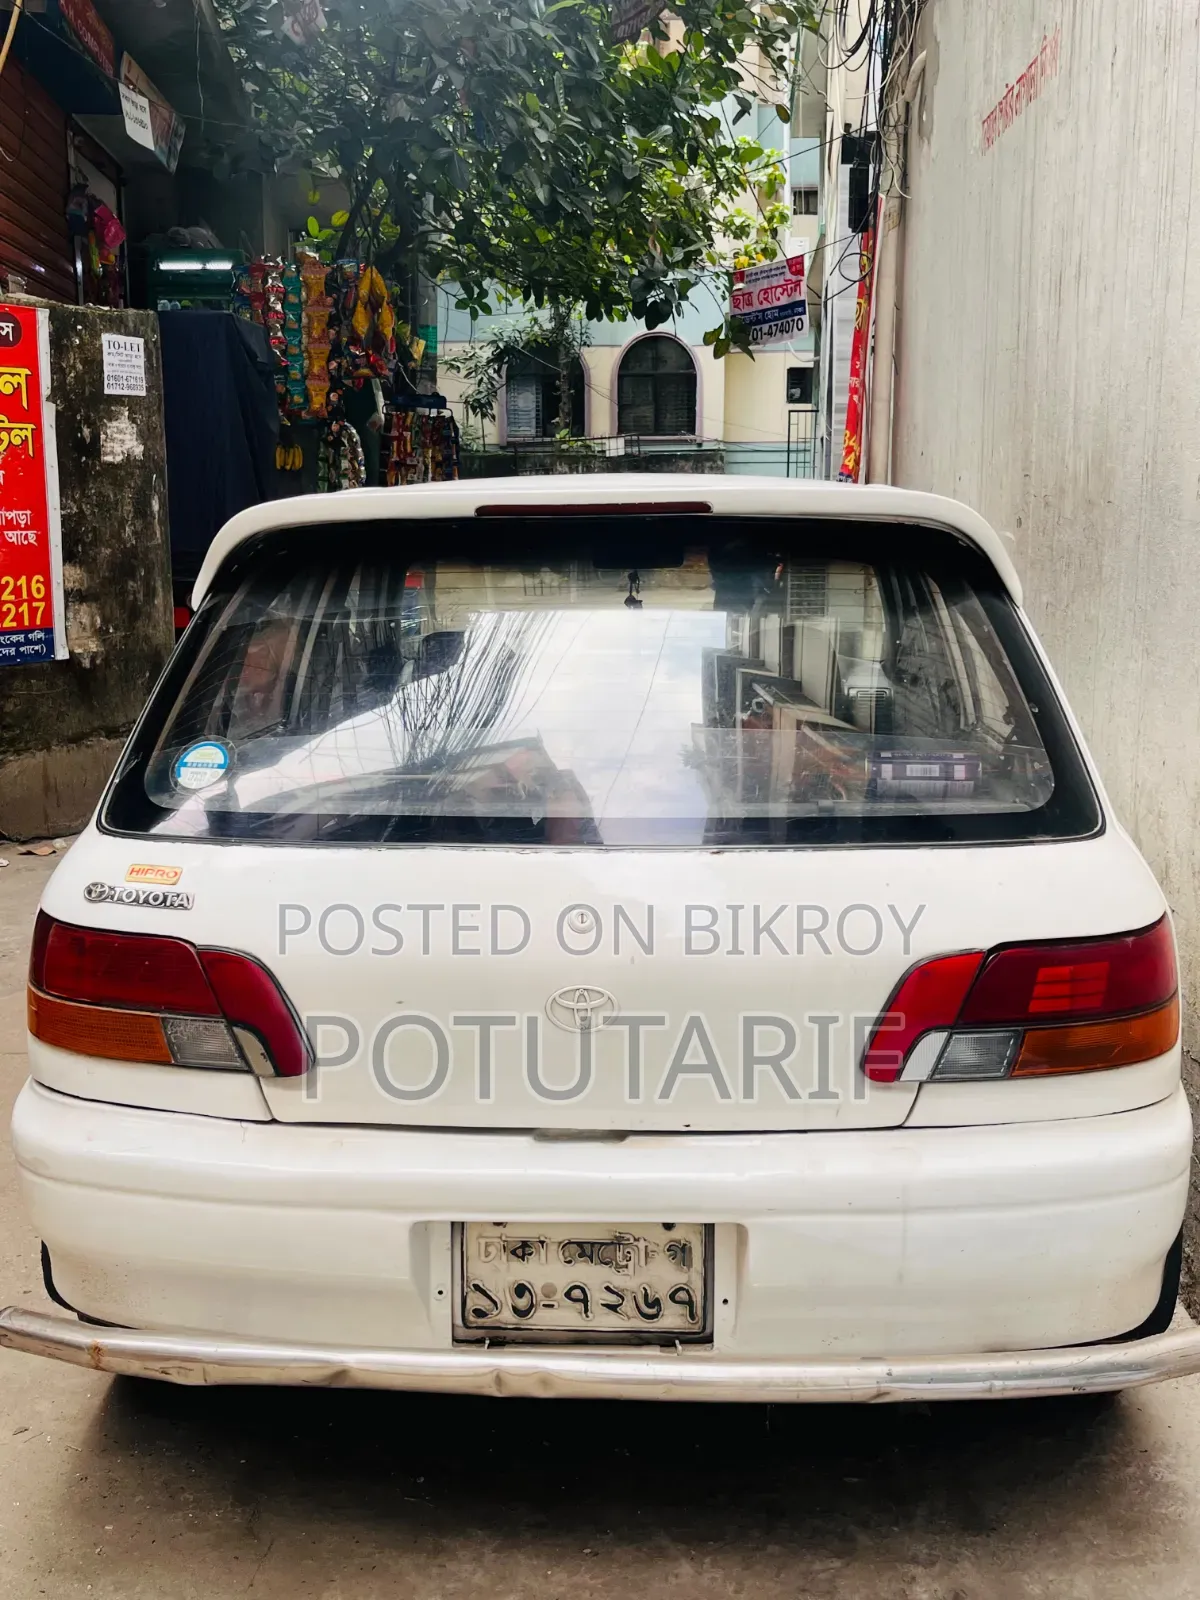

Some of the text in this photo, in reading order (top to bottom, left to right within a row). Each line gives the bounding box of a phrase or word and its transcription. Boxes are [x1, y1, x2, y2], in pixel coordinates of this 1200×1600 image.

[757, 278, 804, 306] হোস্টেল
[751, 317, 804, 342] 01-474070
[106, 340, 140, 352] TO-LET
[3, 530, 38, 547] আছে
[129, 867, 179, 879] HIPRO
[112, 886, 192, 908] TOYOTA
[477, 1234, 549, 1265] ঢাকা
[468, 1279, 699, 1325] ১৩-৭২৬৭
